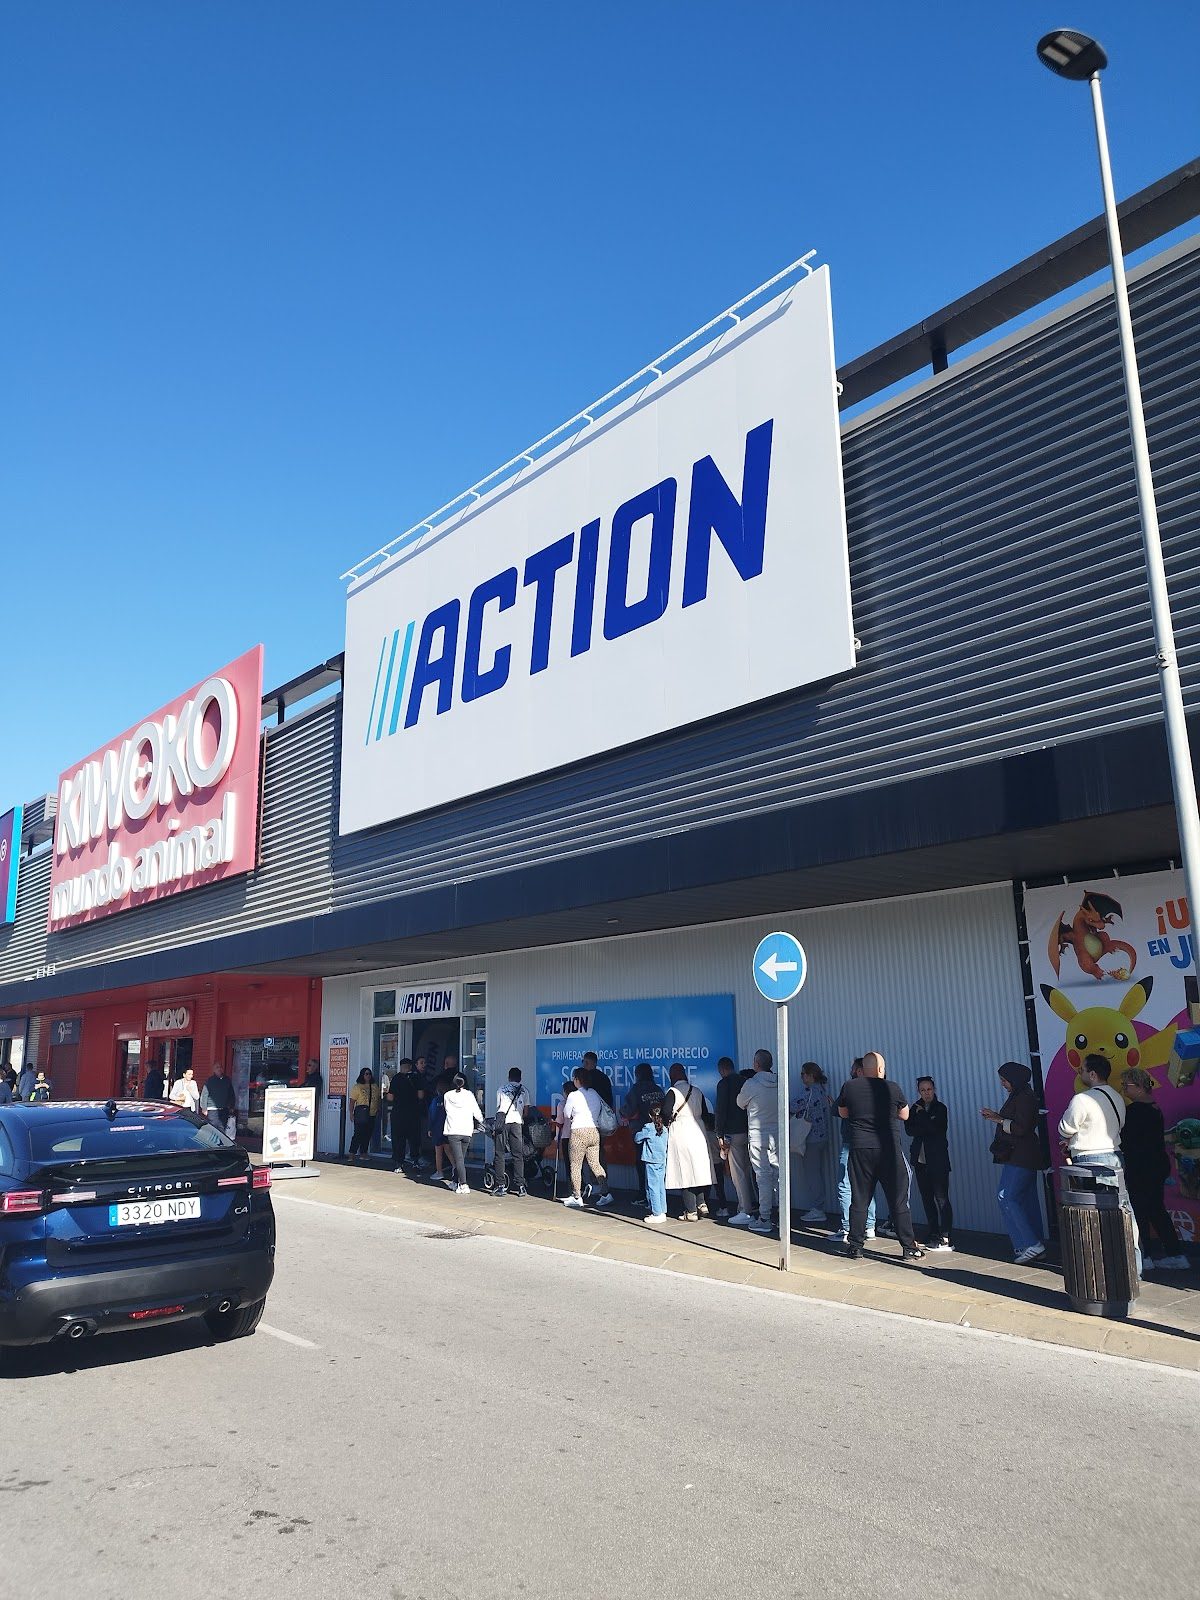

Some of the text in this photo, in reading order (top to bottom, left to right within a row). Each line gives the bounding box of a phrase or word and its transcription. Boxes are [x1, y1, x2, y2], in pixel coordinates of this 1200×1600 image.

[403, 418, 774, 731] ACTION
[57, 678, 238, 855] KIWOKO
[51, 792, 236, 921] mundo animal
[1147, 934, 1194, 969] EN J
[405, 991, 452, 1014] ACTION
[146, 1007, 190, 1031] KIWOKO
[544, 1016, 588, 1035] ACTION
[623, 1049, 634, 1060] EL
[636, 1048, 669, 1059] MEJOR
[671, 1047, 709, 1059] PRECIO
[330, 1068, 347, 1076] HOGAR
[121, 1200, 197, 1221] 3320 NDY
[234, 1206, 249, 1215] C4
